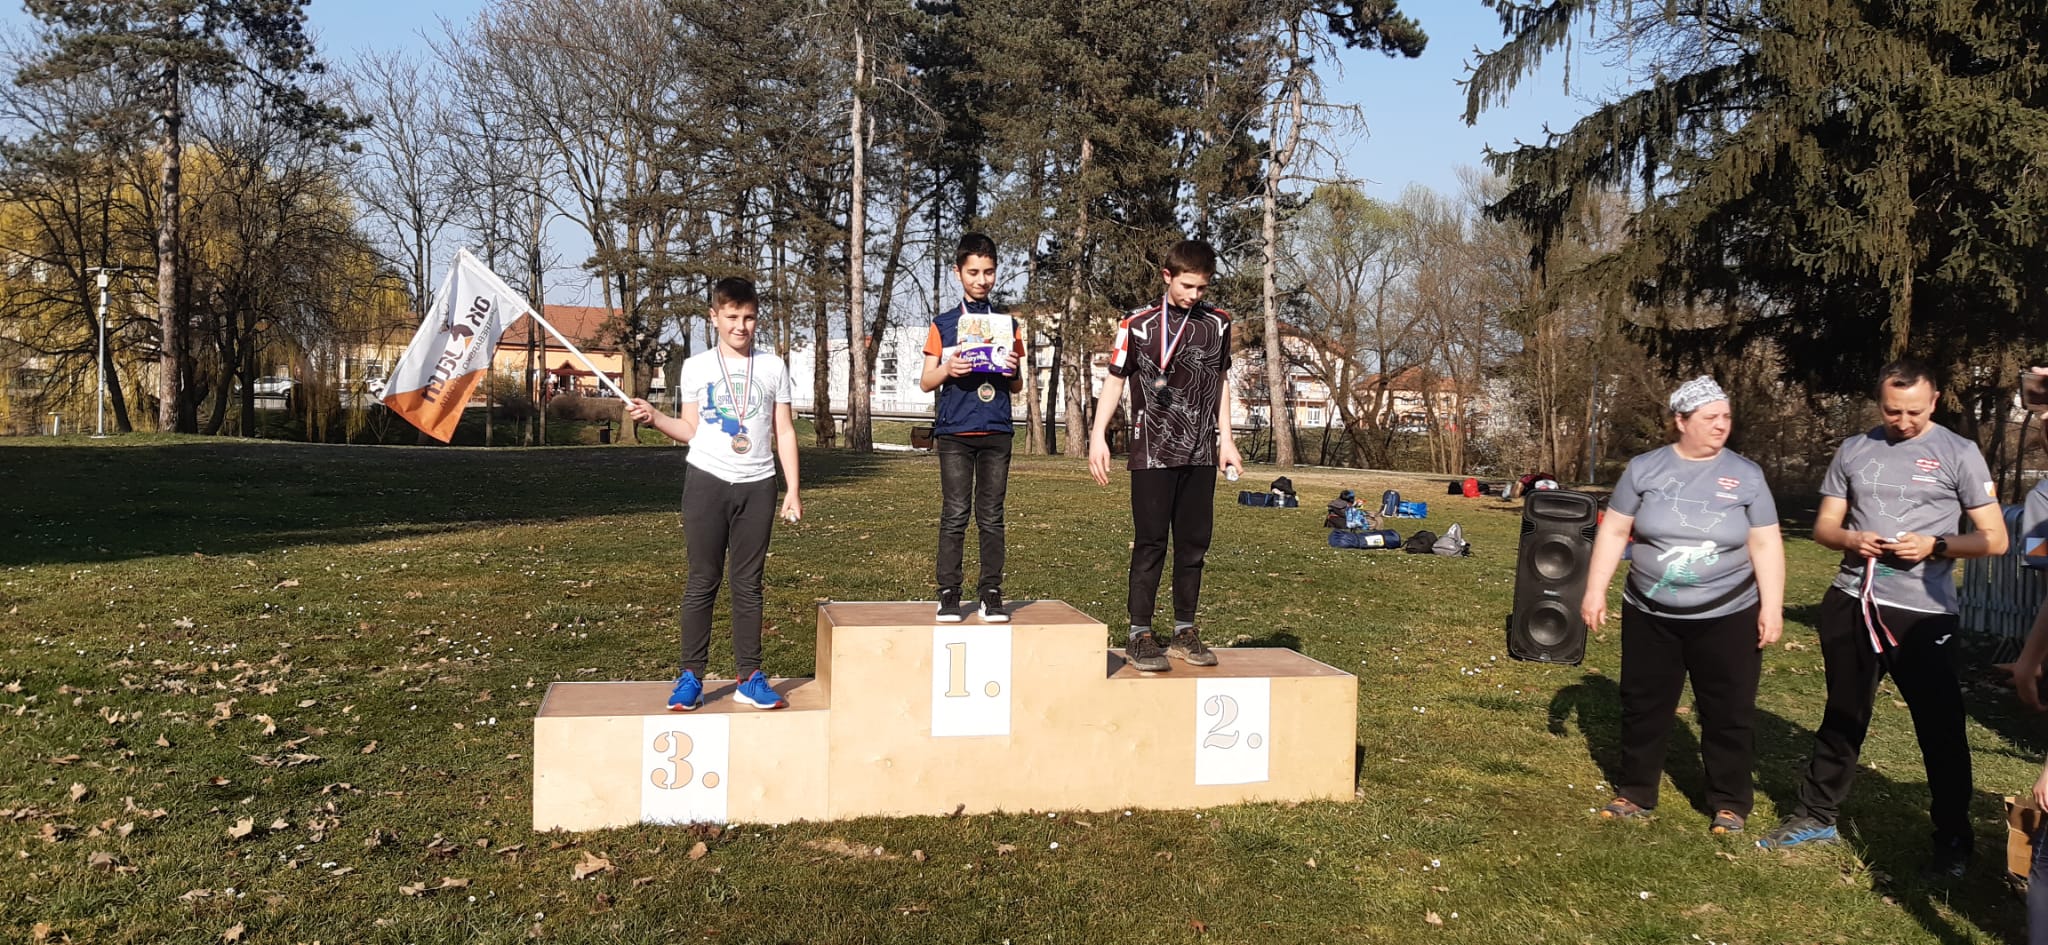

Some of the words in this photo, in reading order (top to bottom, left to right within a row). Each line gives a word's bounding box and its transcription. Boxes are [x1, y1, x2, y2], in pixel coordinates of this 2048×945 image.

[944, 642, 1000, 697] 1.
[1203, 694, 1263, 750] 2.
[650, 731, 720, 789] 3.
